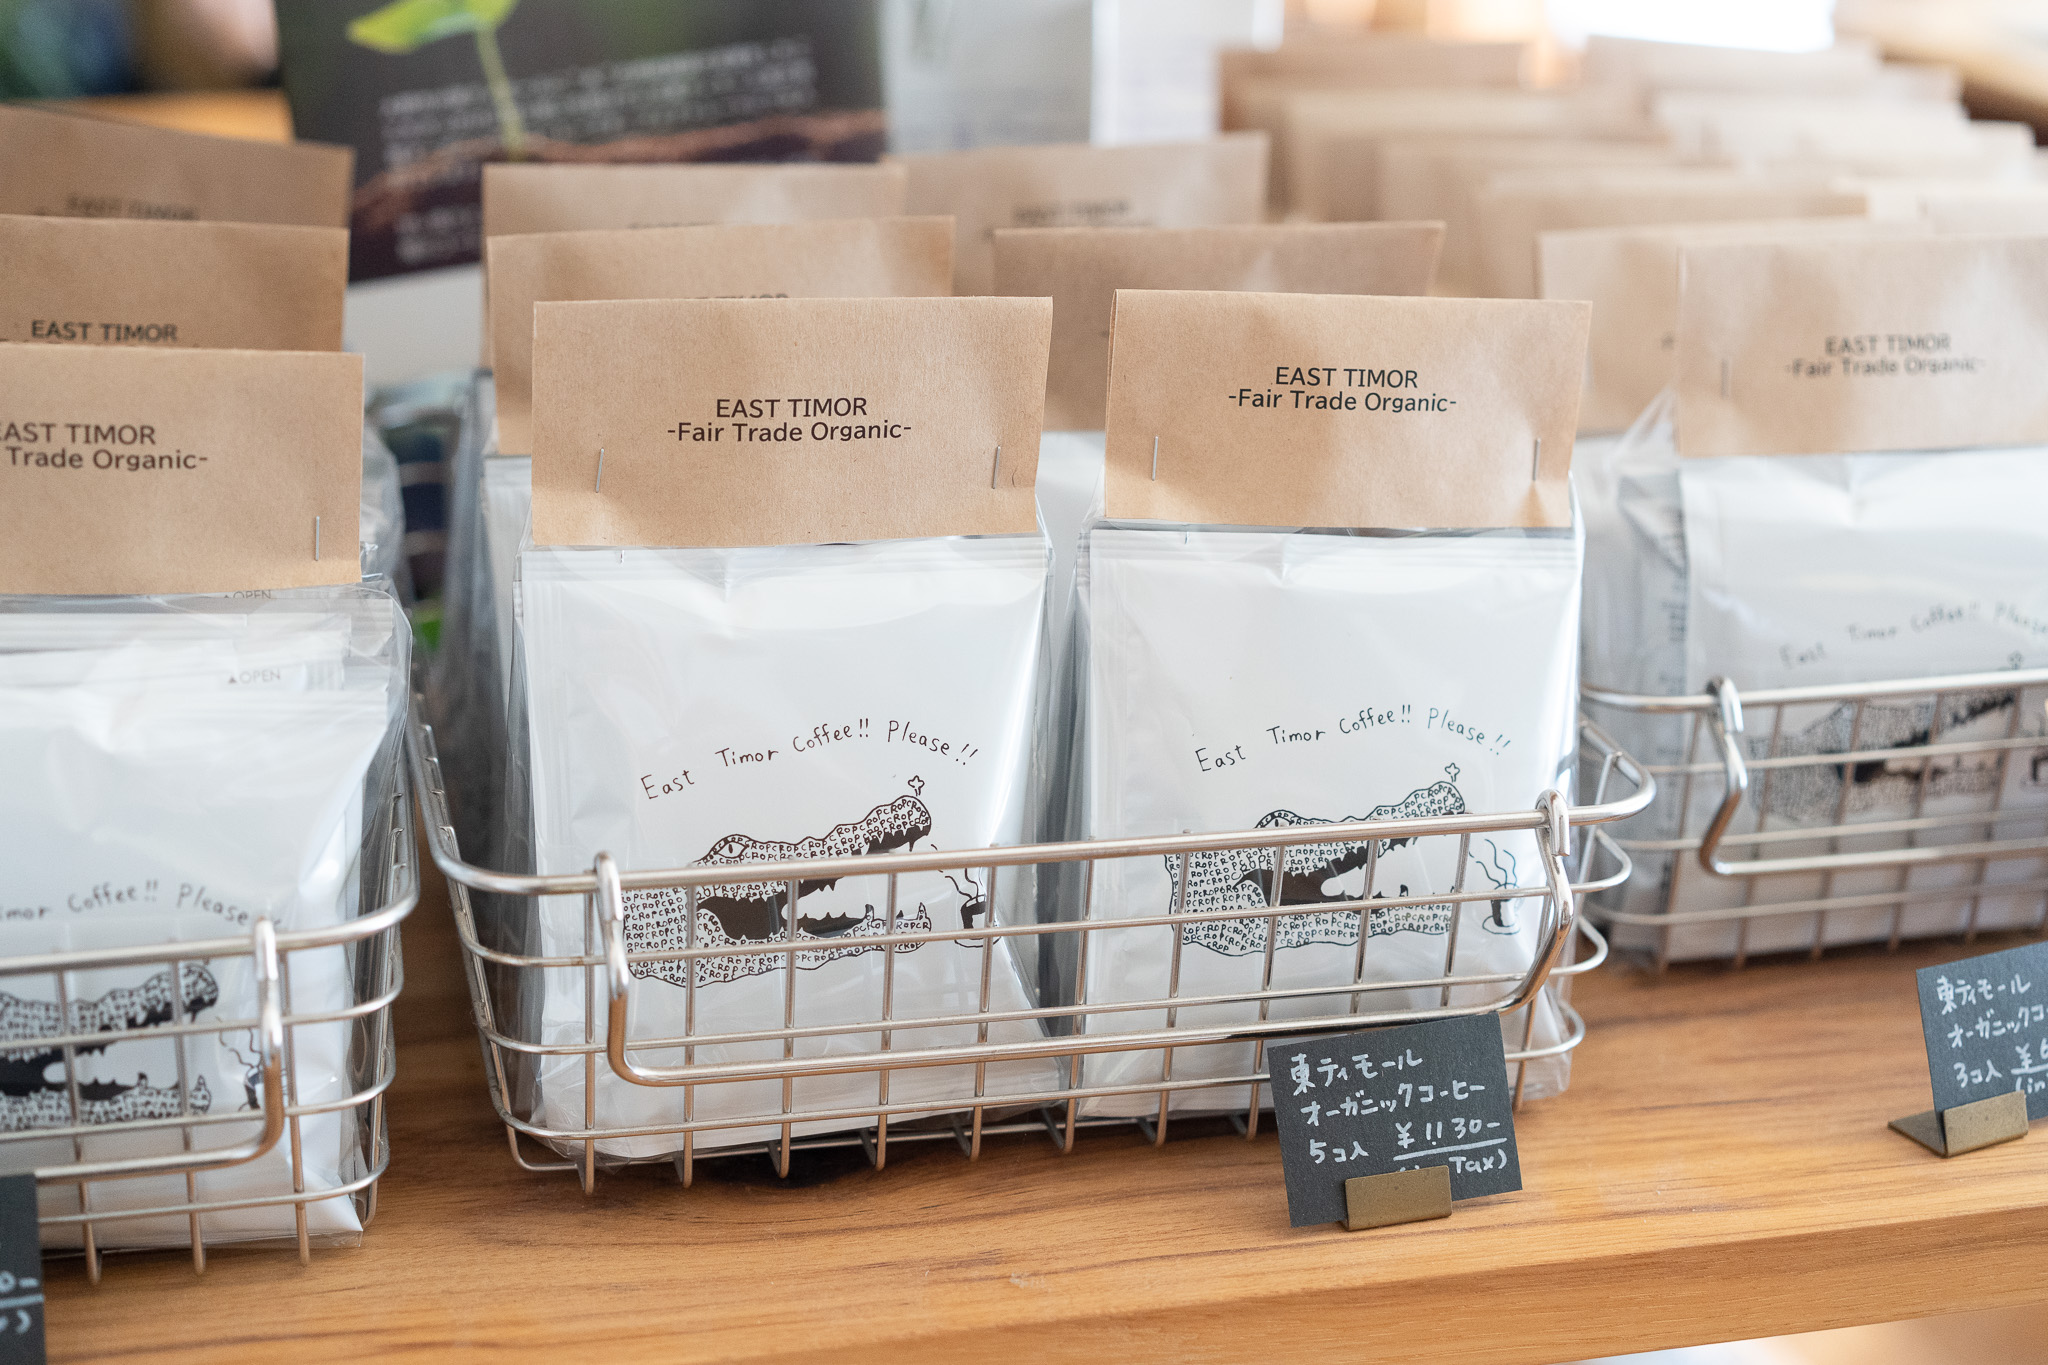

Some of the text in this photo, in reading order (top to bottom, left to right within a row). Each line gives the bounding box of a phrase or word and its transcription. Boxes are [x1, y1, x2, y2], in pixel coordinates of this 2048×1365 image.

[32, 320, 178, 343] EAST TIMOR
[1275, 366, 1418, 389] EAST TIMOR
[716, 397, 868, 418] EAST TIMOR
[1228, 388, 1457, 413] -Fair Trade Organic-
[0, 421, 156, 445] AST TIMOR
[667, 419, 912, 442] -Fair Trade Organic-
[6, 446, 208, 472] Trade Organic-
[240, 668, 281, 684] OPEN
[1195, 745, 1247, 773] East
[1266, 725, 1326, 746] Timor
[1339, 704, 1412, 734] Coffee!!
[640, 769, 695, 800] East
[715, 747, 779, 768] Timor
[793, 718, 870, 753] Coffee!!
[1937, 973, 2031, 1016] 東ティモール
[1947, 1003, 2048, 1048] オーガニックコ
[1290, 1048, 1423, 1096] 東ティモール
[1301, 1079, 1486, 1126] オーガニックコーヒー
[1448, 1148, 1508, 1174] Tax)
